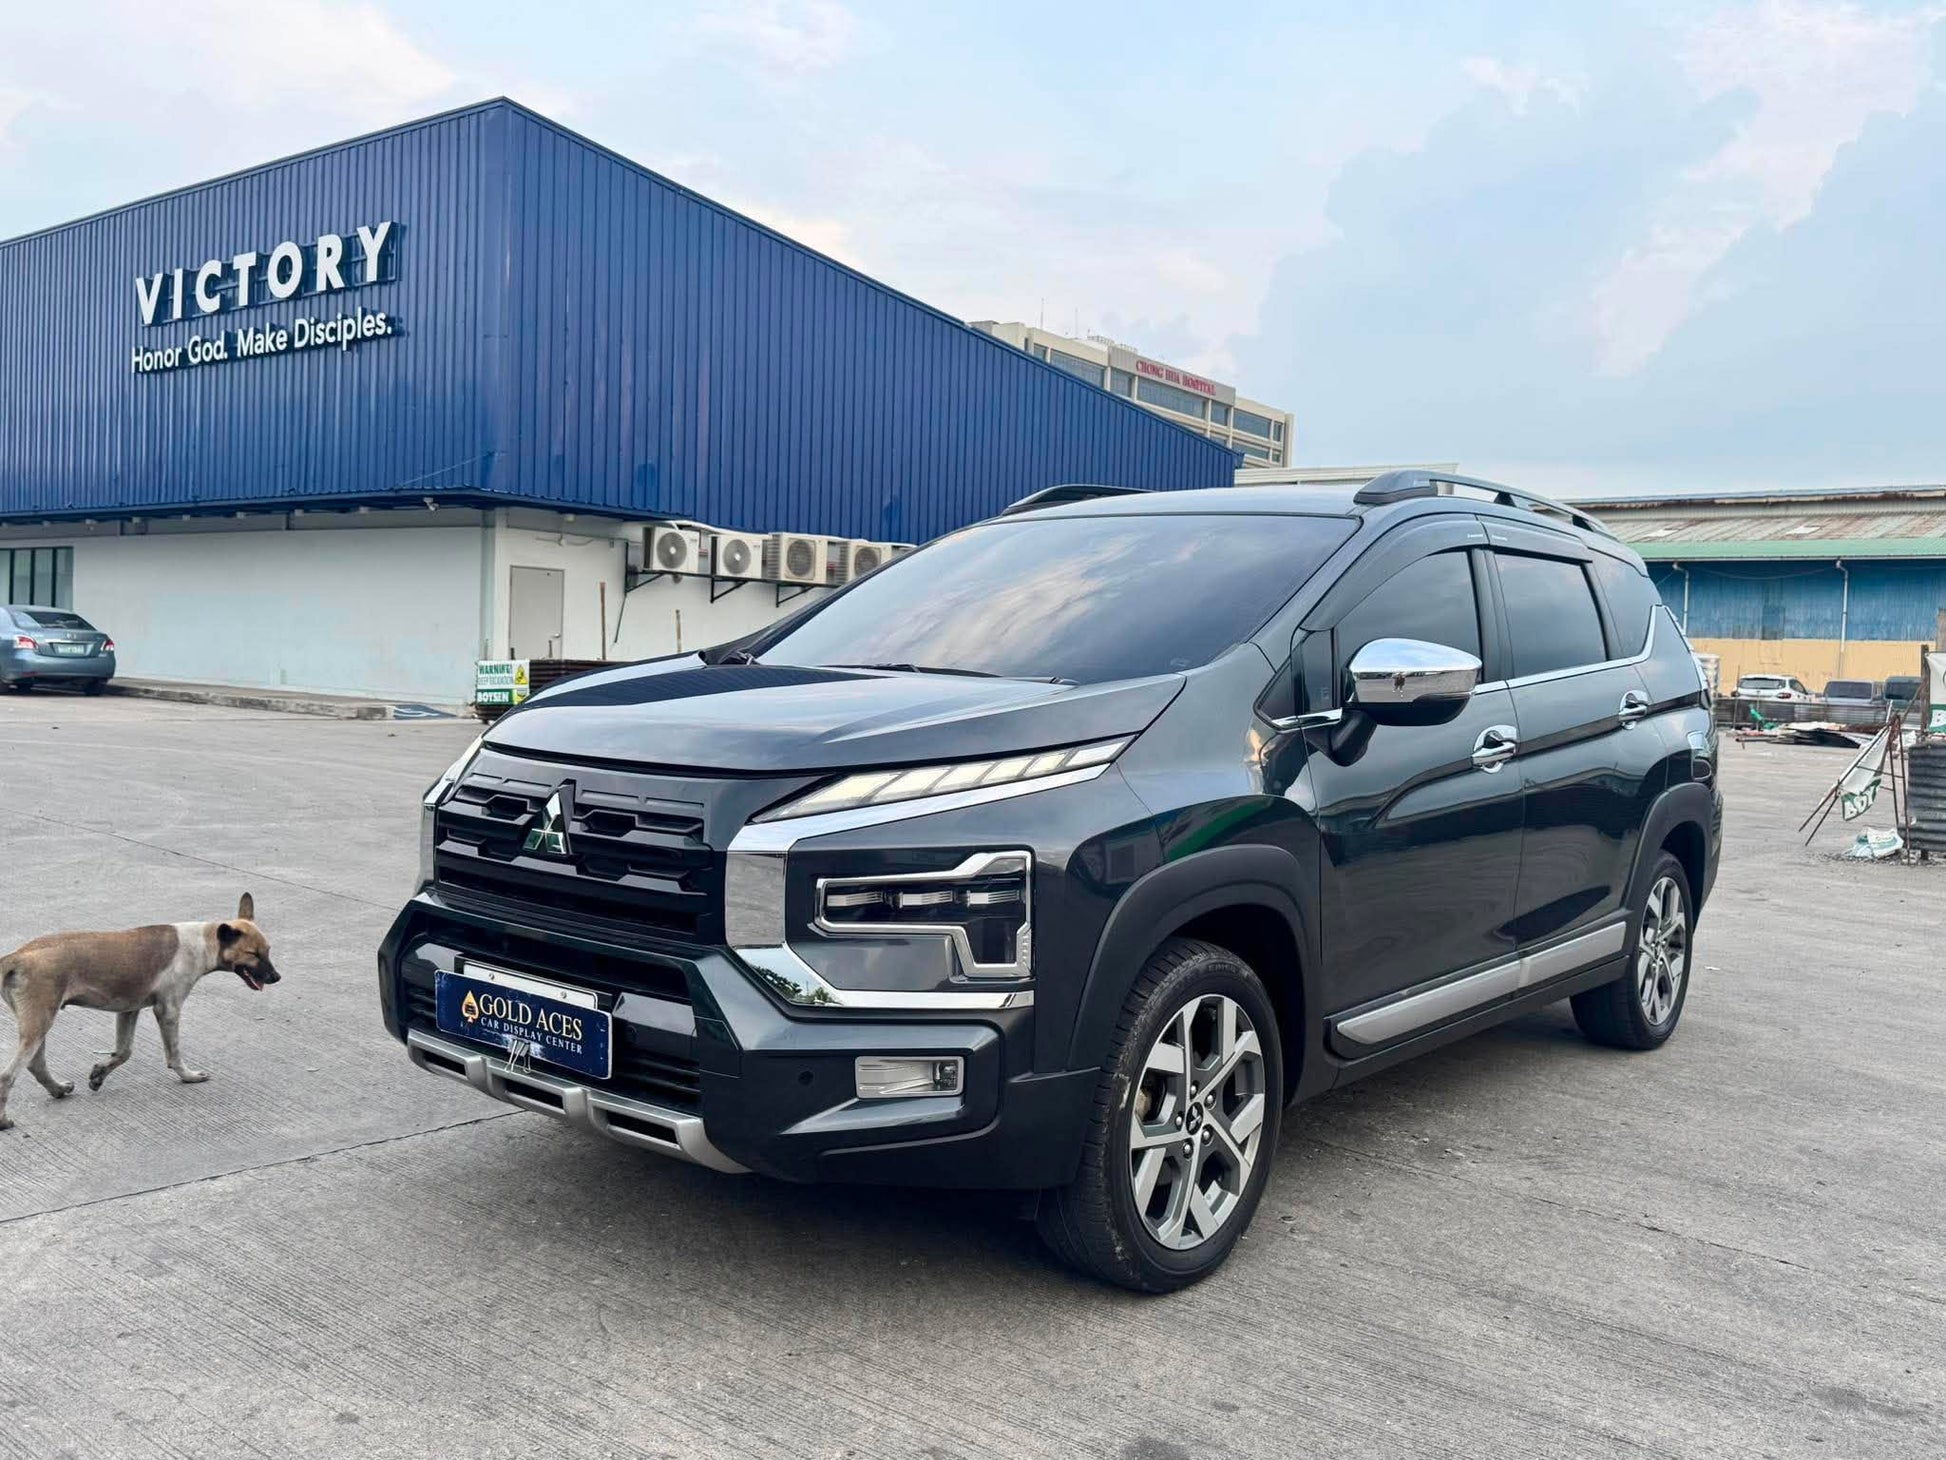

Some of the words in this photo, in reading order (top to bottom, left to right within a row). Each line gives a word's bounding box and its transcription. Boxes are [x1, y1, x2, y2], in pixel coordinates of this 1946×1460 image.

[135, 221, 393, 325] VICTORY
[132, 347, 182, 374] Honor
[188, 329, 229, 365] God.
[236, 322, 288, 358] Make
[294, 306, 393, 351] Disciples.
[1136, 360, 1164, 379] CHONG
[1182, 374, 1216, 396] HOSPITAL
[476, 691, 510, 703] BOYSEN
[479, 993, 532, 1025] GOLD
[536, 1008, 583, 1041] ACES
[480, 1017, 500, 1030] CAR
[503, 1022, 543, 1043] DISPLAY
[545, 1035, 583, 1055] CENTER
